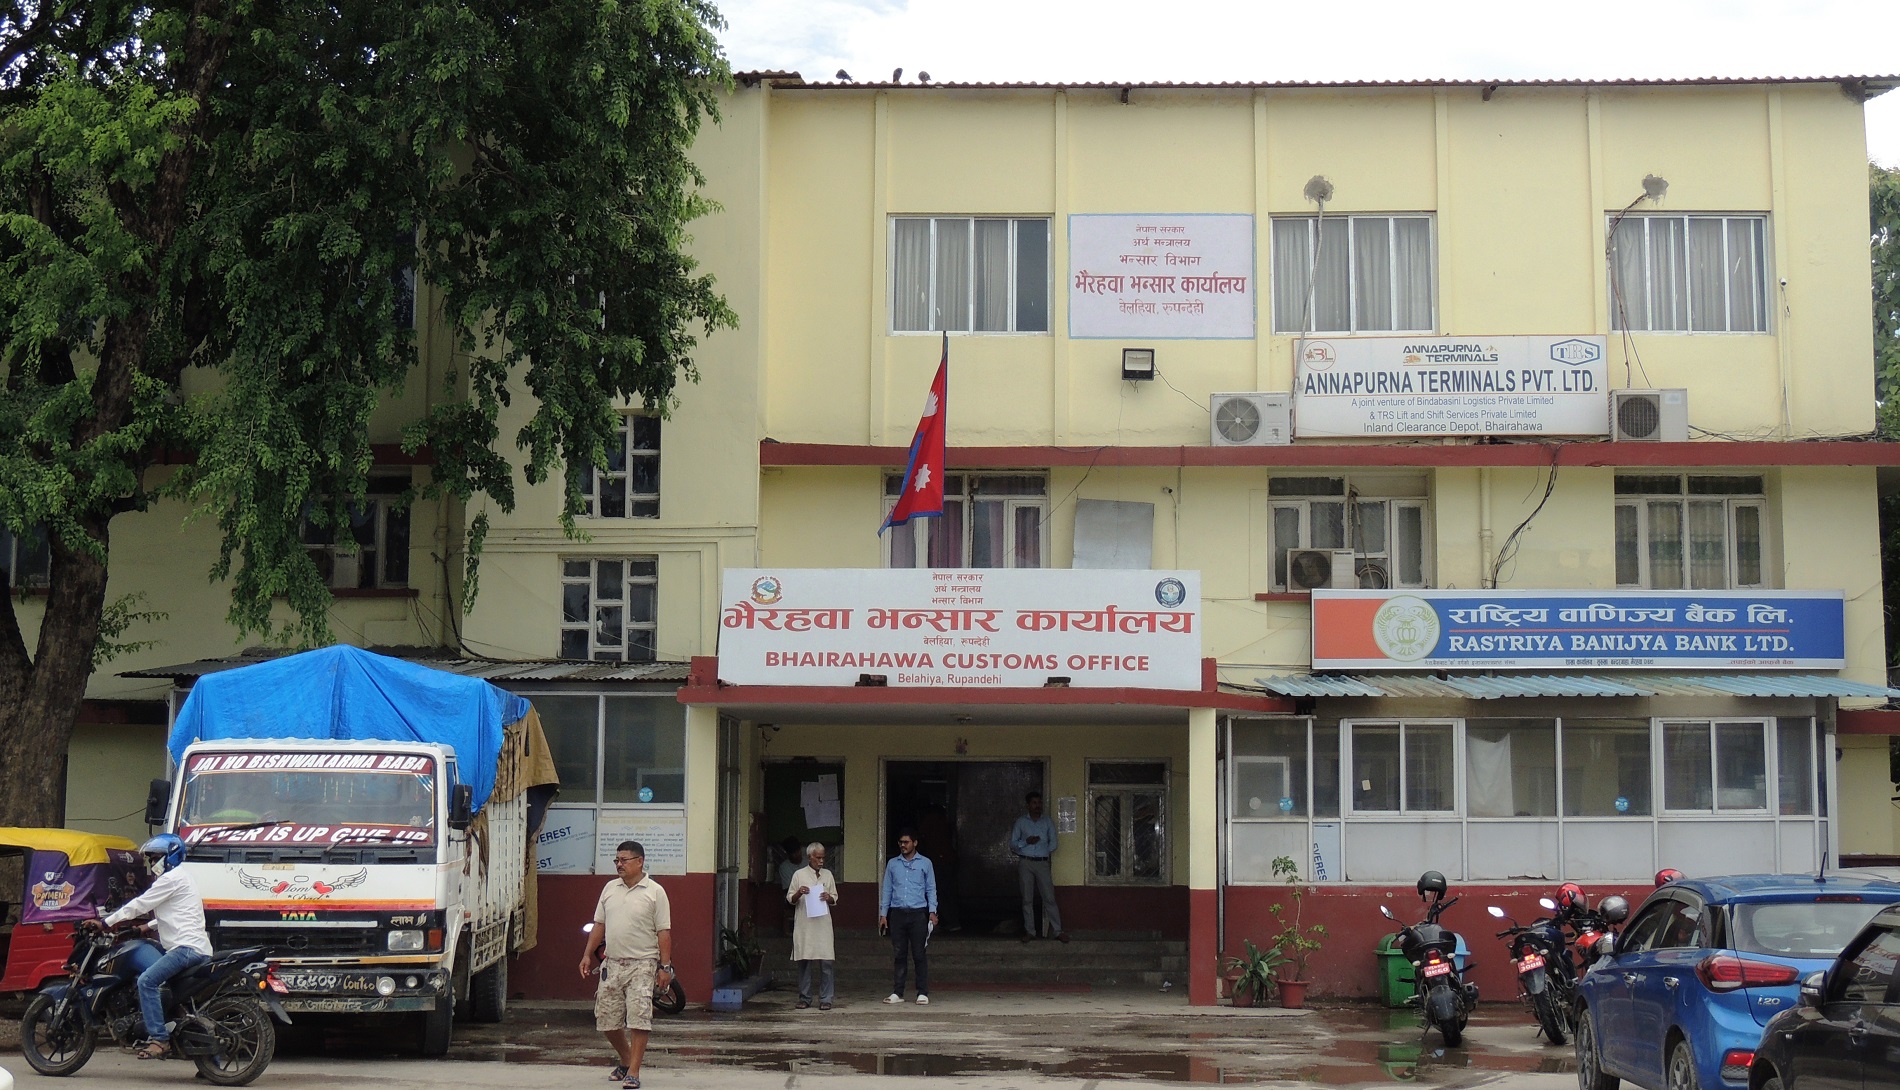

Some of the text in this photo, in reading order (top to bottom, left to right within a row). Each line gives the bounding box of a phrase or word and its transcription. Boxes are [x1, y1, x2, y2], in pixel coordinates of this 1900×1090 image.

[1159, 226, 1185, 234] सरकार
[1133, 237, 1191, 247] अर्थ मन्त्रालय
[1119, 252, 1201, 267] भन्सार विभाग
[1075, 269, 1246, 295] भैरहवा भन्सार कार्यालय
[1403, 345, 1482, 353] ANNAPURNA
[1425, 353, 1498, 362] TERMINALS
[1304, 369, 1598, 395] ANNAPURNA TERMINALS PVT. LTD.
[1351, 396, 1554, 409] A joint venture of Bindabasini Logistics Private Limited
[1369, 409, 1537, 420] & TRS Lift and Shift Services Private Limited
[1363, 421, 1543, 433] Inland Clearance Depot, Bhairahawa
[932, 572, 984, 582] नेपाल सरकार
[934, 583, 982, 593] अर्थ मन्त्रालय
[931, 595, 983, 605] भन्सार विभाग
[723, 600, 1195, 634] भैरहवा भन्सार कार्यालय
[1559, 603, 1676, 623] वाणिज्य
[1747, 604, 1794, 623] लि.
[1449, 635, 1794, 652] RASTRIYA BANIJYA BANK LTD.
[765, 651, 1149, 671] BHAIRAHAWA CUSTOMS OFFICE
[898, 673, 1001, 686] Belahiya, Rupandehi
[191, 754, 428, 771] JAI HO BISHWAKARMA BABA
[184, 826, 265, 842] NEVER
[264, 826, 293, 841] IS
[292, 827, 330, 842] UP
[330, 827, 391, 843] GIVE
[280, 910, 317, 921] TATA
